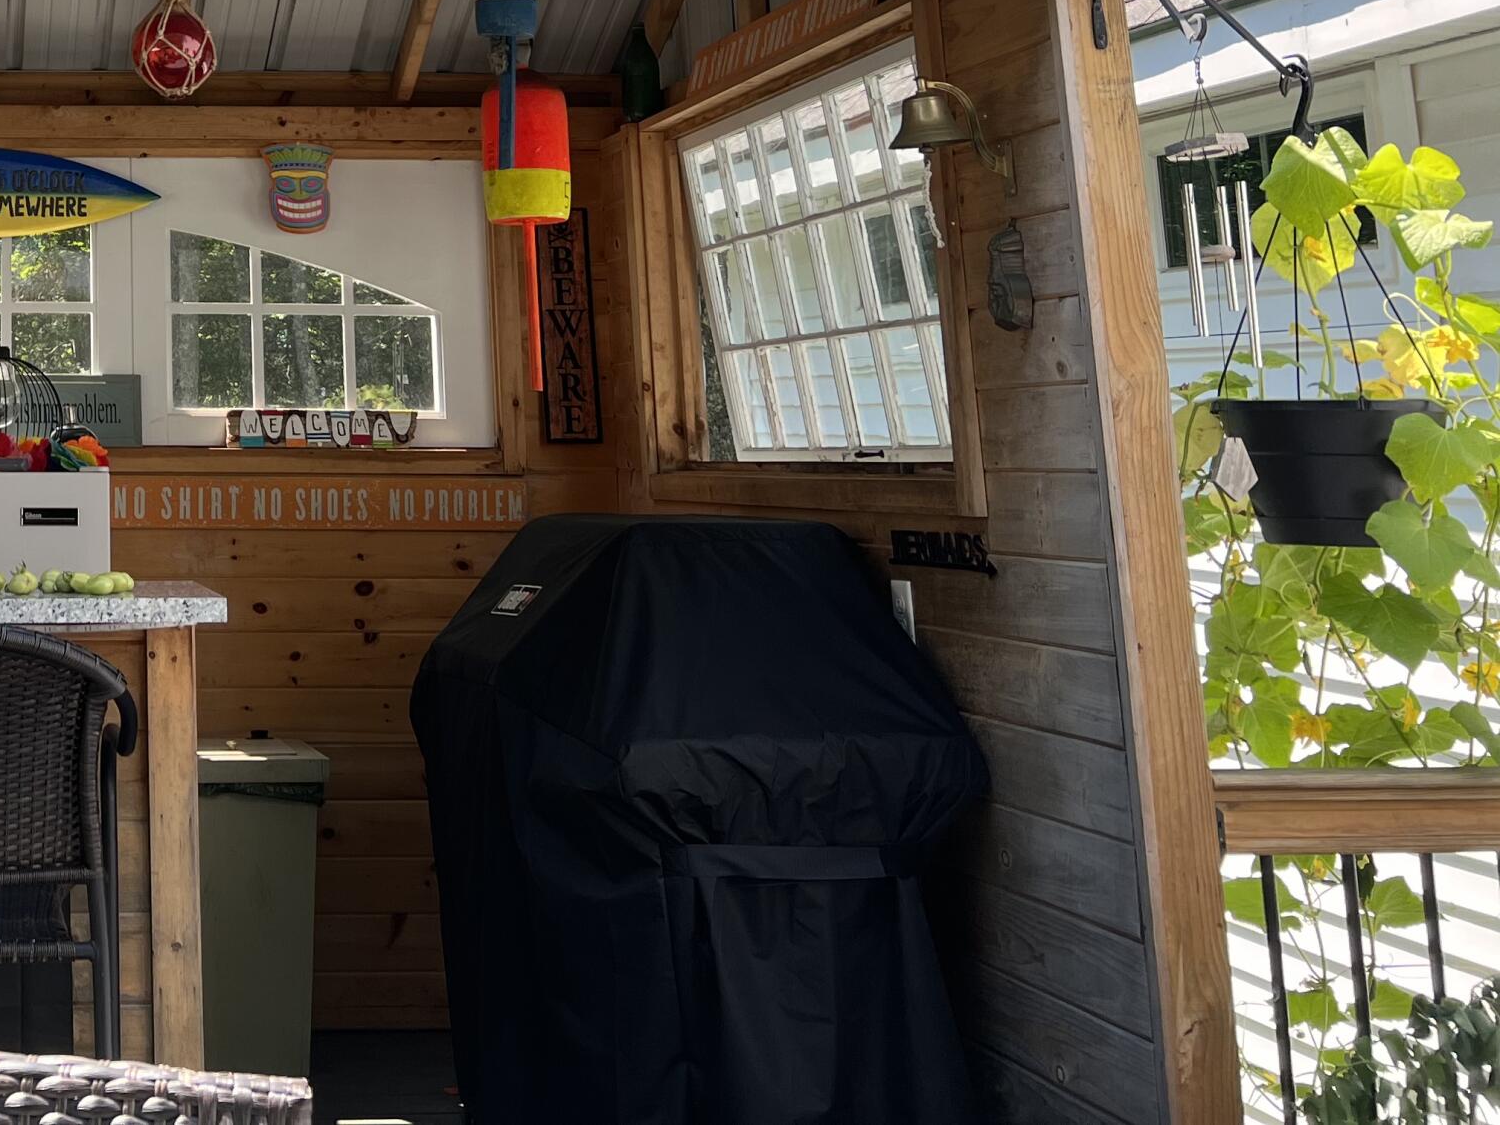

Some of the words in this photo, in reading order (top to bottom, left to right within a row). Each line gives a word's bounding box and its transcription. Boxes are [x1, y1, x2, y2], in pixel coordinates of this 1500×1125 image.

[545, 246, 587, 435] BEWARE
[15, 392, 58, 432] ishing
[243, 413, 388, 439] WELCOME
[114, 486, 146, 520] NO
[161, 485, 239, 521] SHIRT
[254, 486, 282, 521] NO
[295, 487, 368, 521] SHOES
[389, 488, 415, 522] NO
[423, 488, 523, 522] PROBLEM
